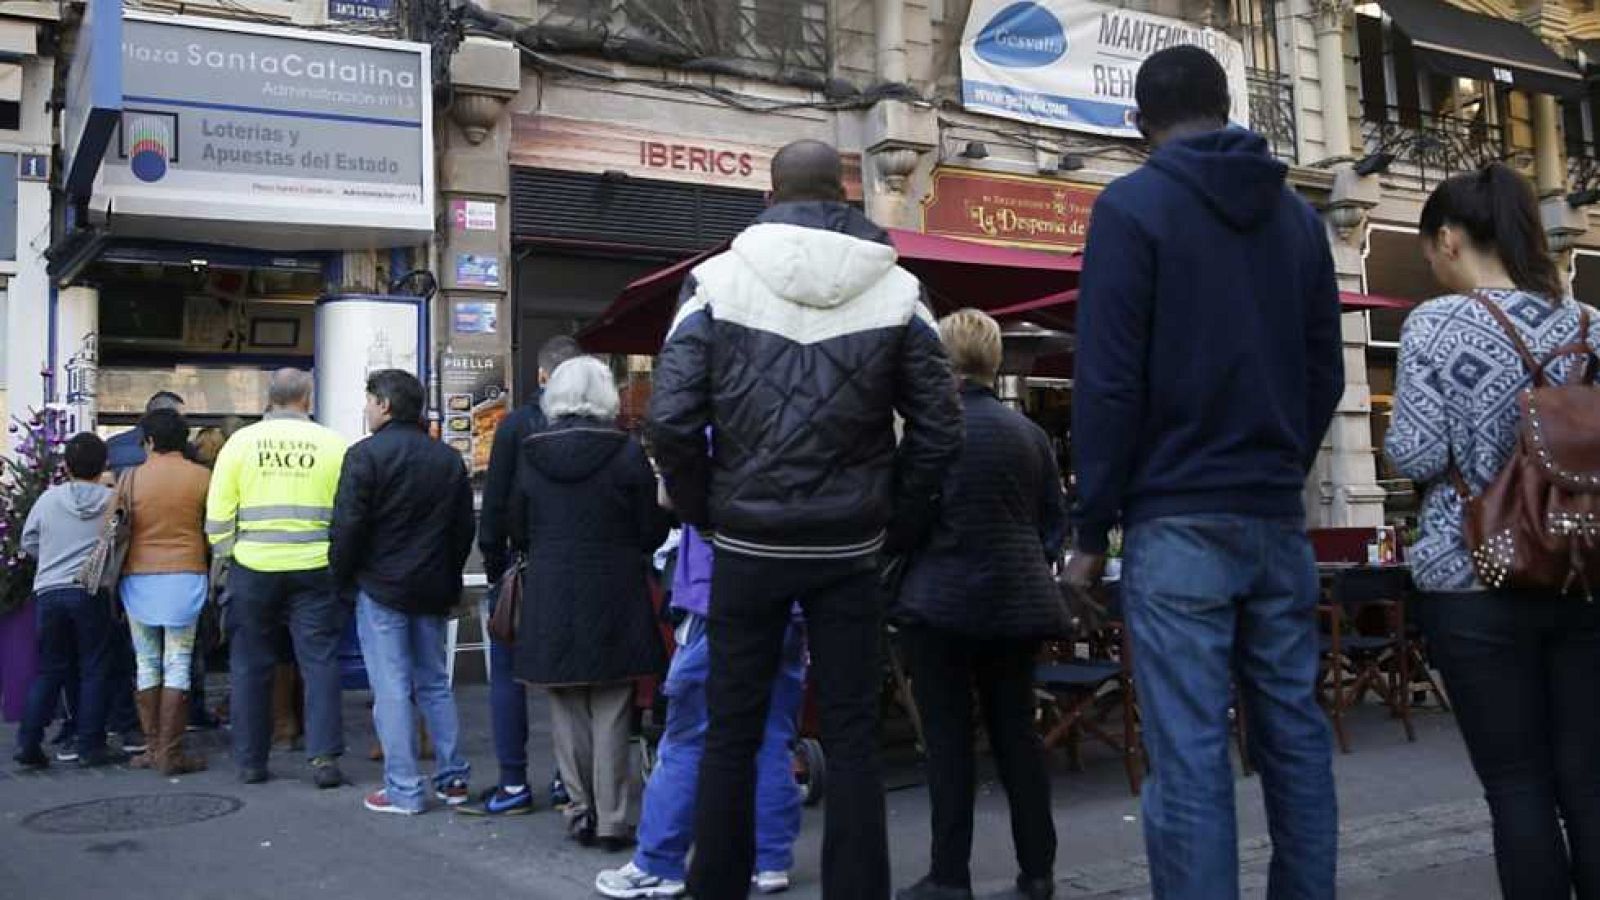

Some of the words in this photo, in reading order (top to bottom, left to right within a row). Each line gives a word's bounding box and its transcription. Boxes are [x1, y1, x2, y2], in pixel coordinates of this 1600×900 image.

[121, 42, 179, 64] laza
[186, 43, 415, 88] SantaCatalina
[1094, 63, 1134, 98] REH
[289, 130, 299, 147] y
[201, 143, 295, 168] Apuestas
[301, 150, 329, 169] del
[335, 152, 399, 173] Estado
[639, 140, 753, 177] IBERICS
[1070, 220, 1085, 235] de
[258, 452, 315, 469] PACO
